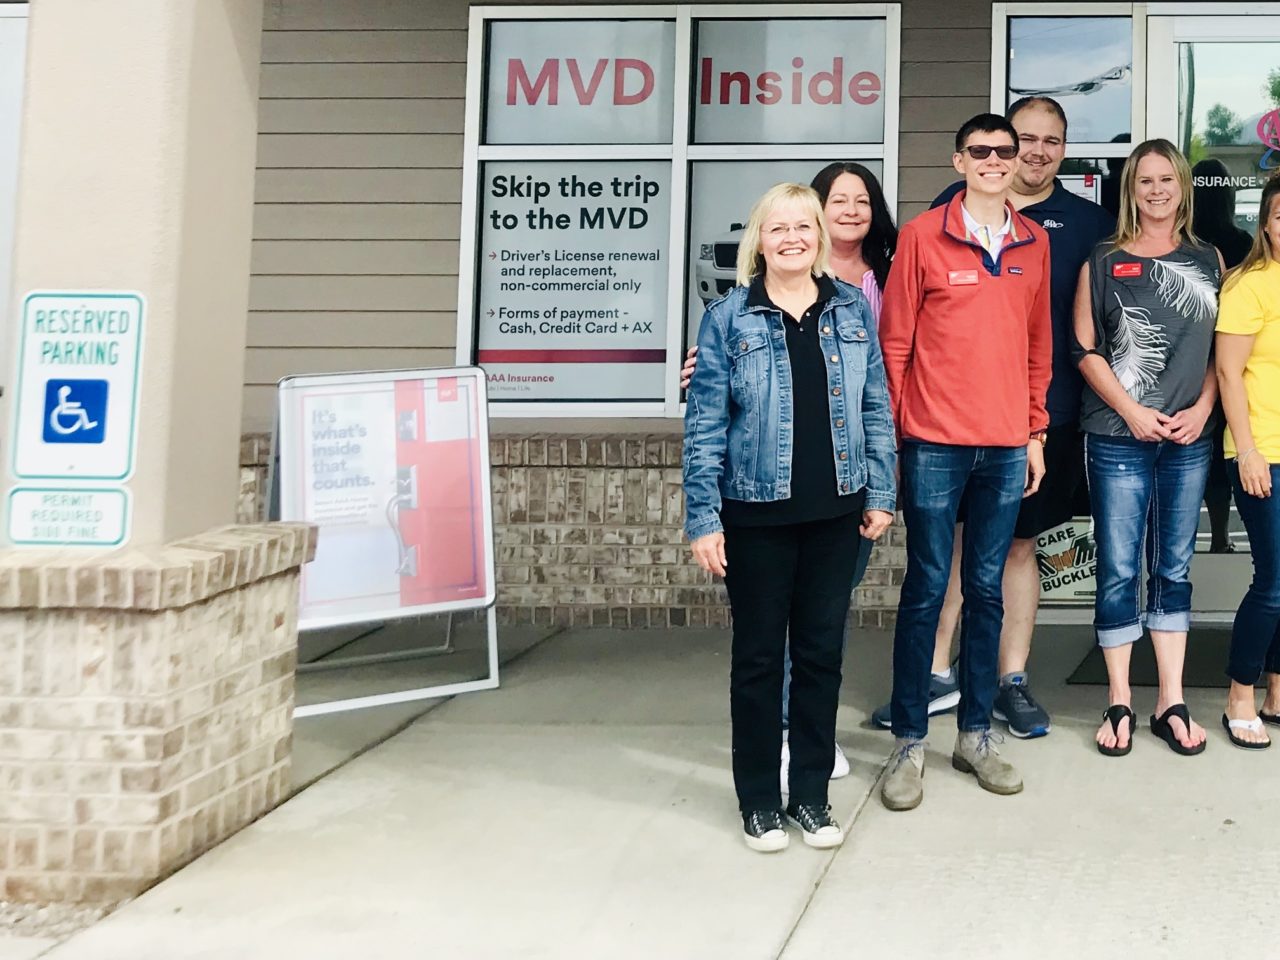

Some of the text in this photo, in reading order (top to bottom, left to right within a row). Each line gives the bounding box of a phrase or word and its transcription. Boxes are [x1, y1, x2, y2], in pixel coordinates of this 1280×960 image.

[506, 56, 881, 106] MVD Inside
[491, 174, 660, 204] Skip the trip
[1191, 176, 1256, 187] NSURANCE
[489, 207, 649, 230] to the MVD
[501, 249, 660, 262] Driver's License renewal
[500, 264, 617, 280] and replacement,
[500, 279, 642, 294] non-commercial only
[34, 309, 130, 334] RESERVED
[499, 307, 540, 319] Forms
[543, 306, 557, 319] of
[560, 308, 619, 322] payment
[499, 322, 537, 335] Cash,
[539, 322, 581, 334] Credit
[585, 322, 618, 334] Card
[632, 322, 653, 333] AX
[40, 341, 120, 366] PARKING
[507, 373, 555, 383] Insurance
[312, 409, 337, 425] It's
[312, 424, 367, 441] what's
[312, 443, 361, 458] inside
[312, 460, 347, 474] that
[312, 475, 376, 491] counts.
[42, 494, 94, 507] PERMIT
[1036, 526, 1076, 548] CARE
